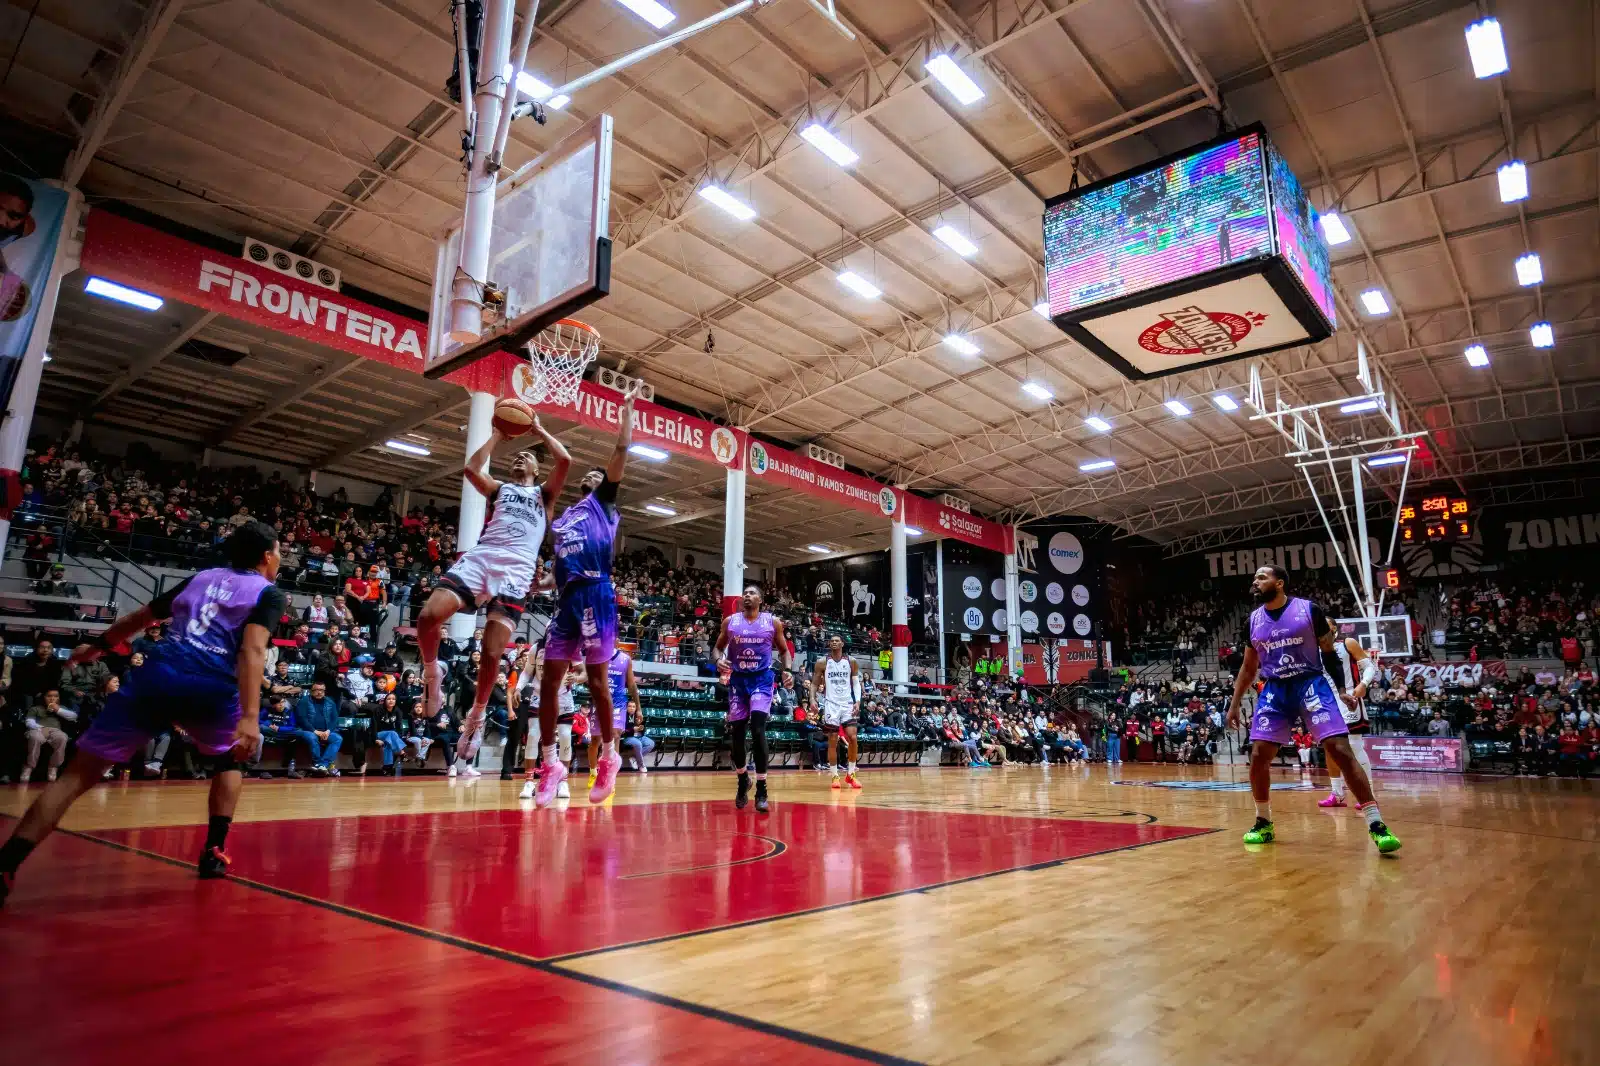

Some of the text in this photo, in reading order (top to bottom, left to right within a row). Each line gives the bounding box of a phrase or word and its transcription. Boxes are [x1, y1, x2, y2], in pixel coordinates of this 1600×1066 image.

[199, 259, 424, 361] FRONTERA
[769, 458, 815, 484] BAJAROUND
[1422, 497, 1448, 511] 2:50
[1452, 501, 1468, 514] 28
[1400, 507, 1416, 519] 36
[951, 514, 983, 535] Salazar
[1050, 547, 1080, 559] Comex
[1260, 636, 1304, 654] VENADOS
